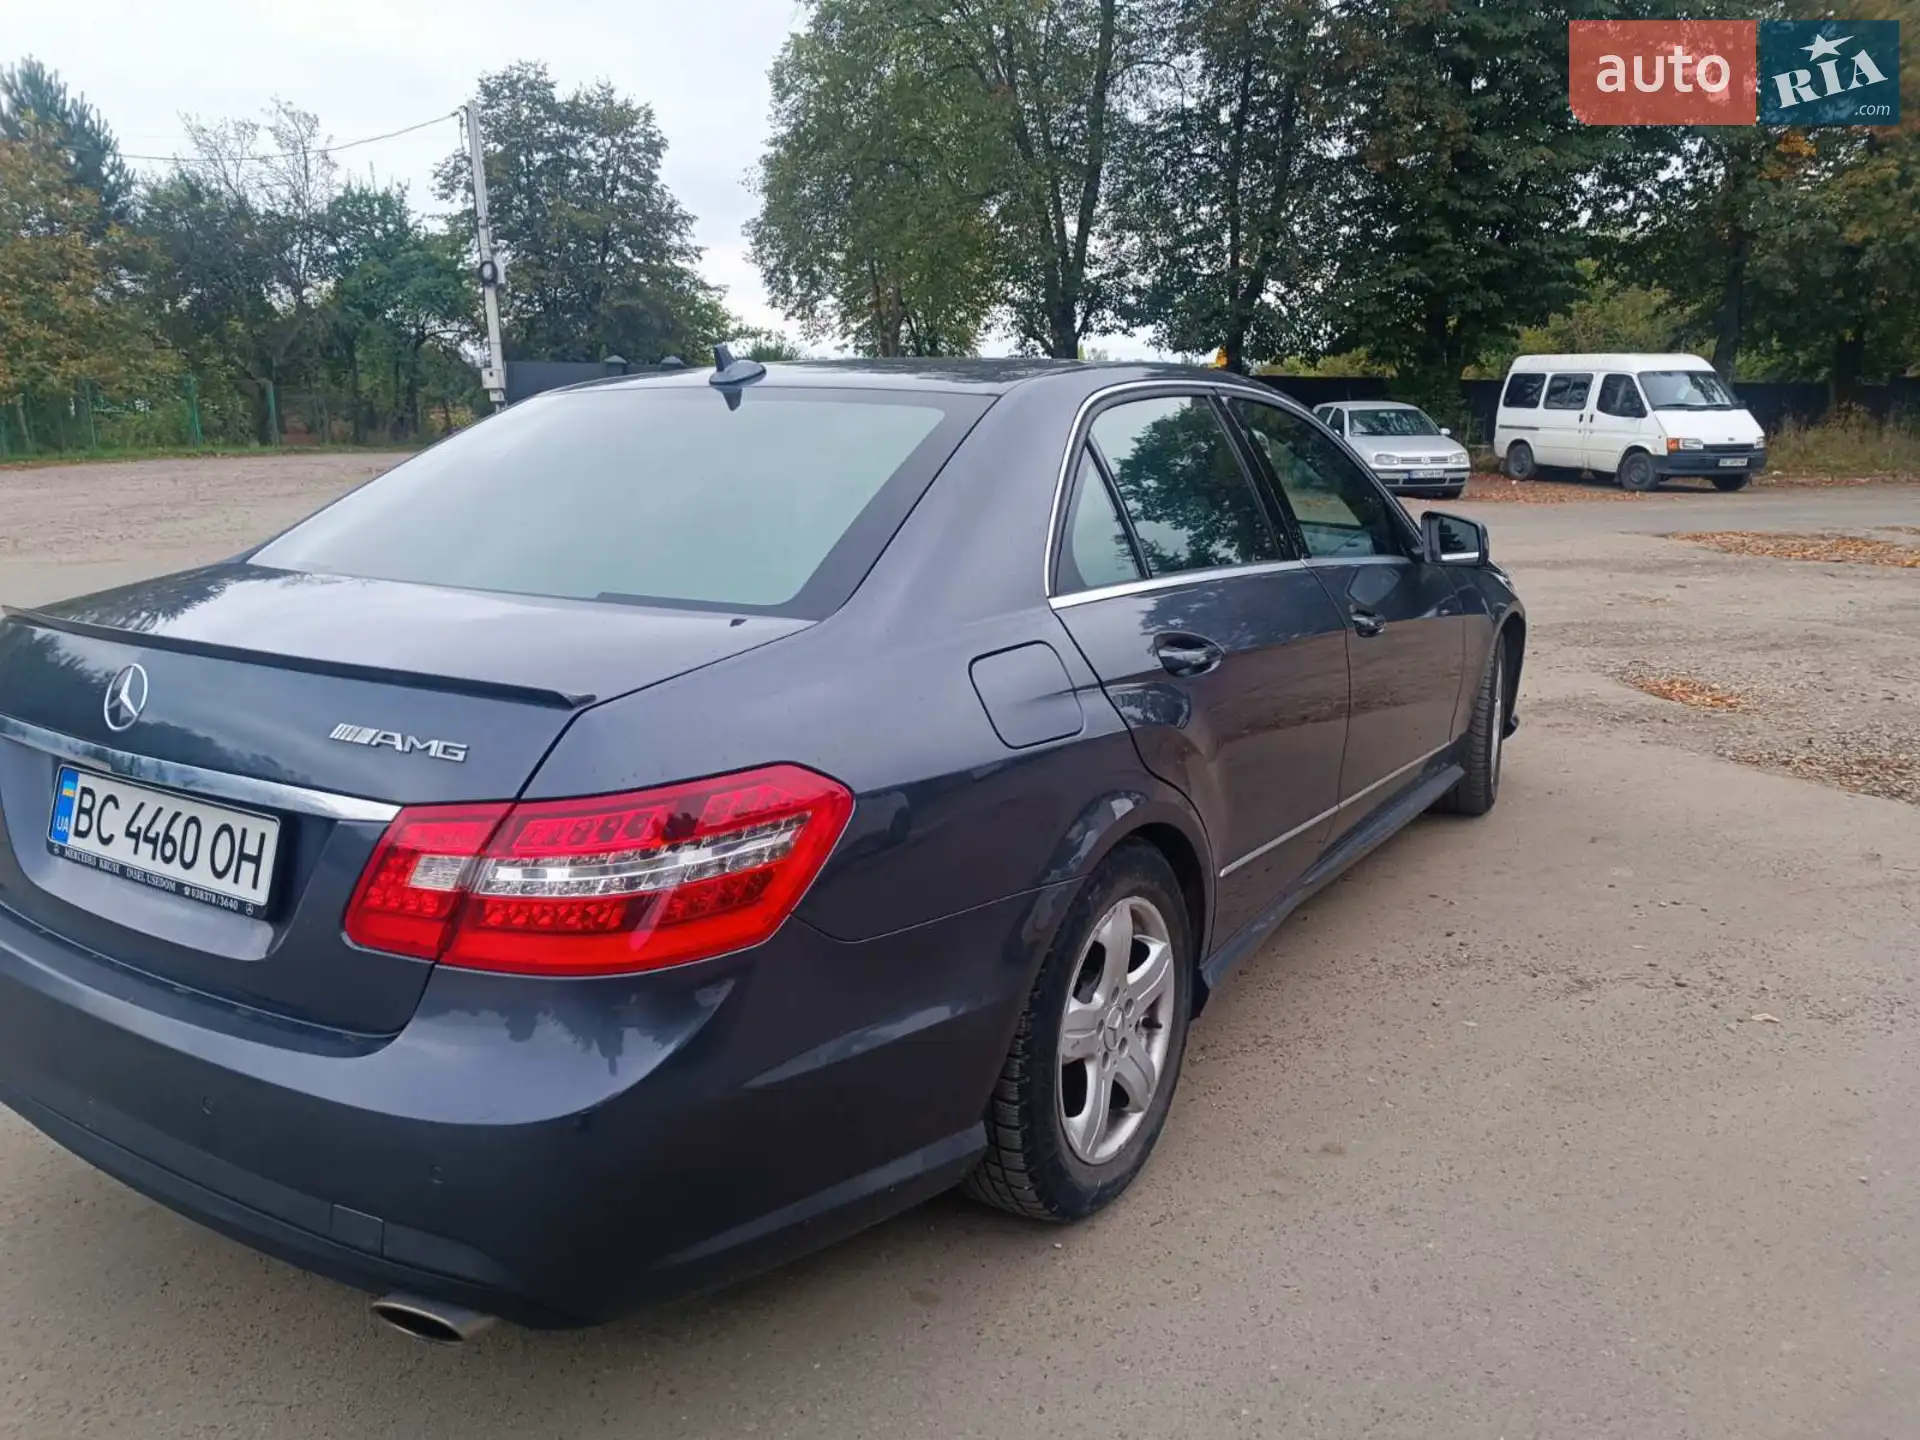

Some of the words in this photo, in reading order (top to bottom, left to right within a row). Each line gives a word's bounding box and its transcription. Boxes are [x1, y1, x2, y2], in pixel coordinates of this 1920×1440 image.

[370, 730, 468, 762] AMG
[56, 815, 69, 832] UA
[73, 785, 120, 846] BC
[124, 801, 202, 871] 4460
[209, 823, 267, 890] OH
[146, 874, 176, 892] USEDOM
